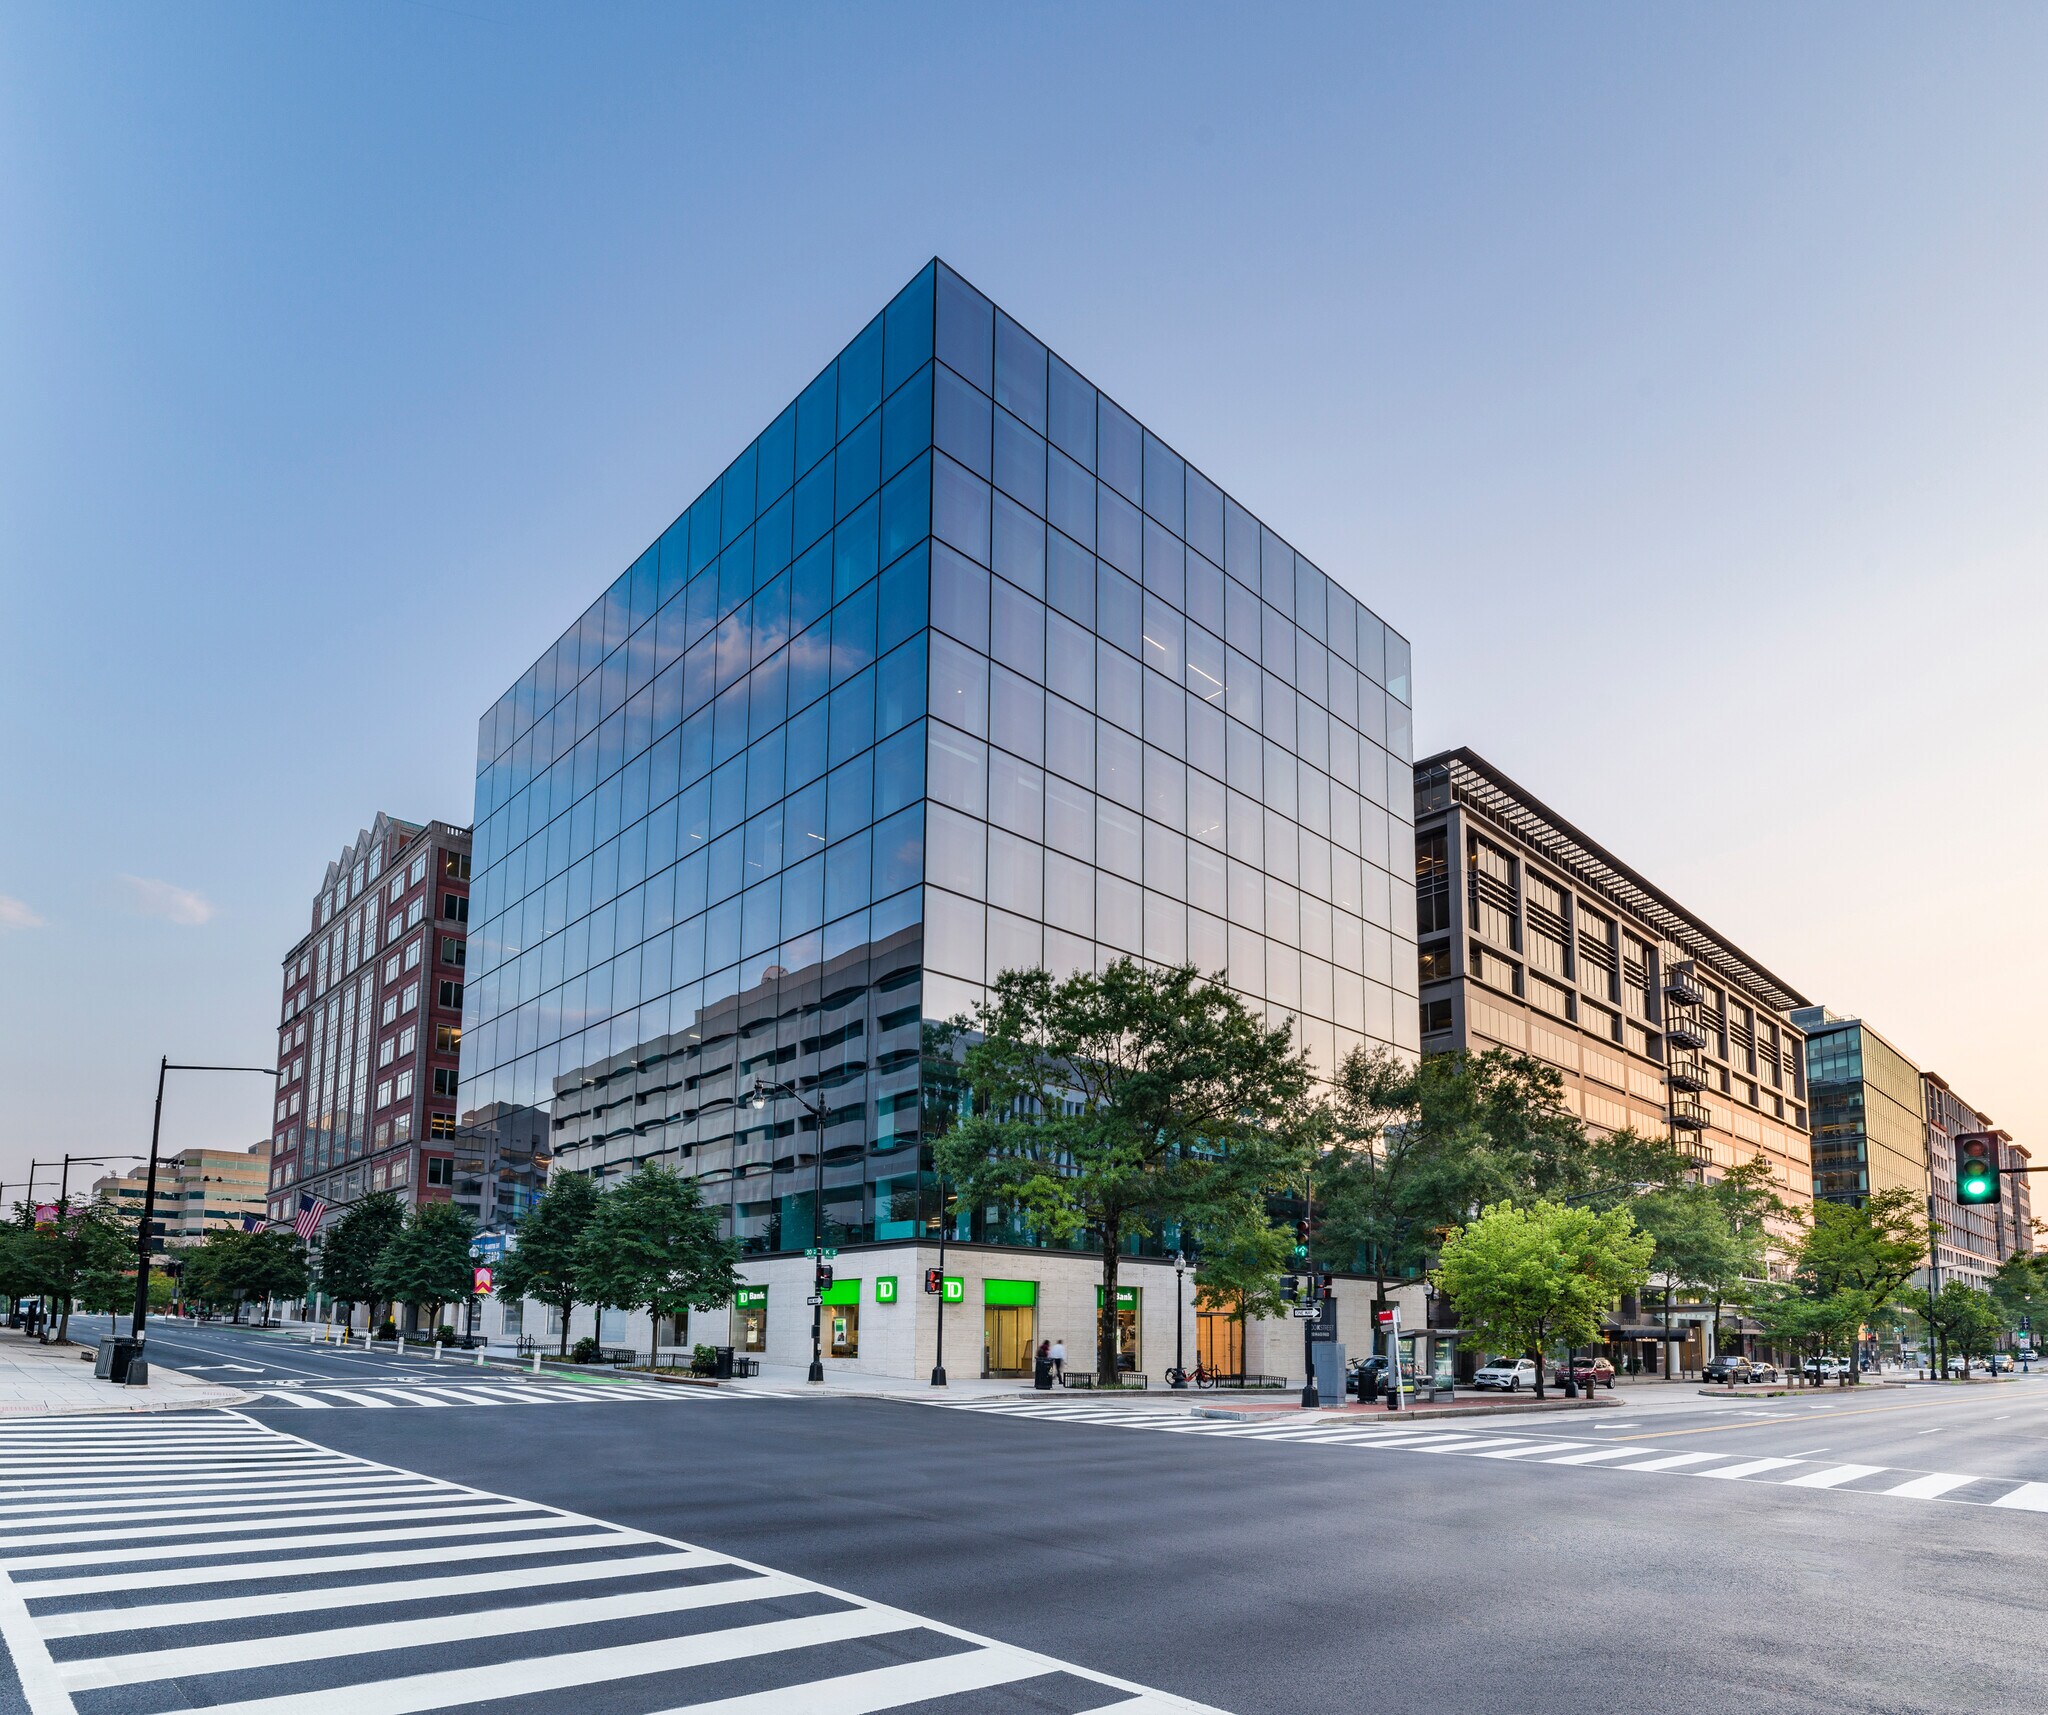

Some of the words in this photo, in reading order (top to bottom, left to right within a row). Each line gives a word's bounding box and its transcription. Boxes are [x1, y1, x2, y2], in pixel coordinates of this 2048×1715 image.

[739, 1292, 748, 1303] TD
[749, 1291, 765, 1300] Bank
[878, 1281, 893, 1298] TD
[944, 1281, 962, 1298] TD
